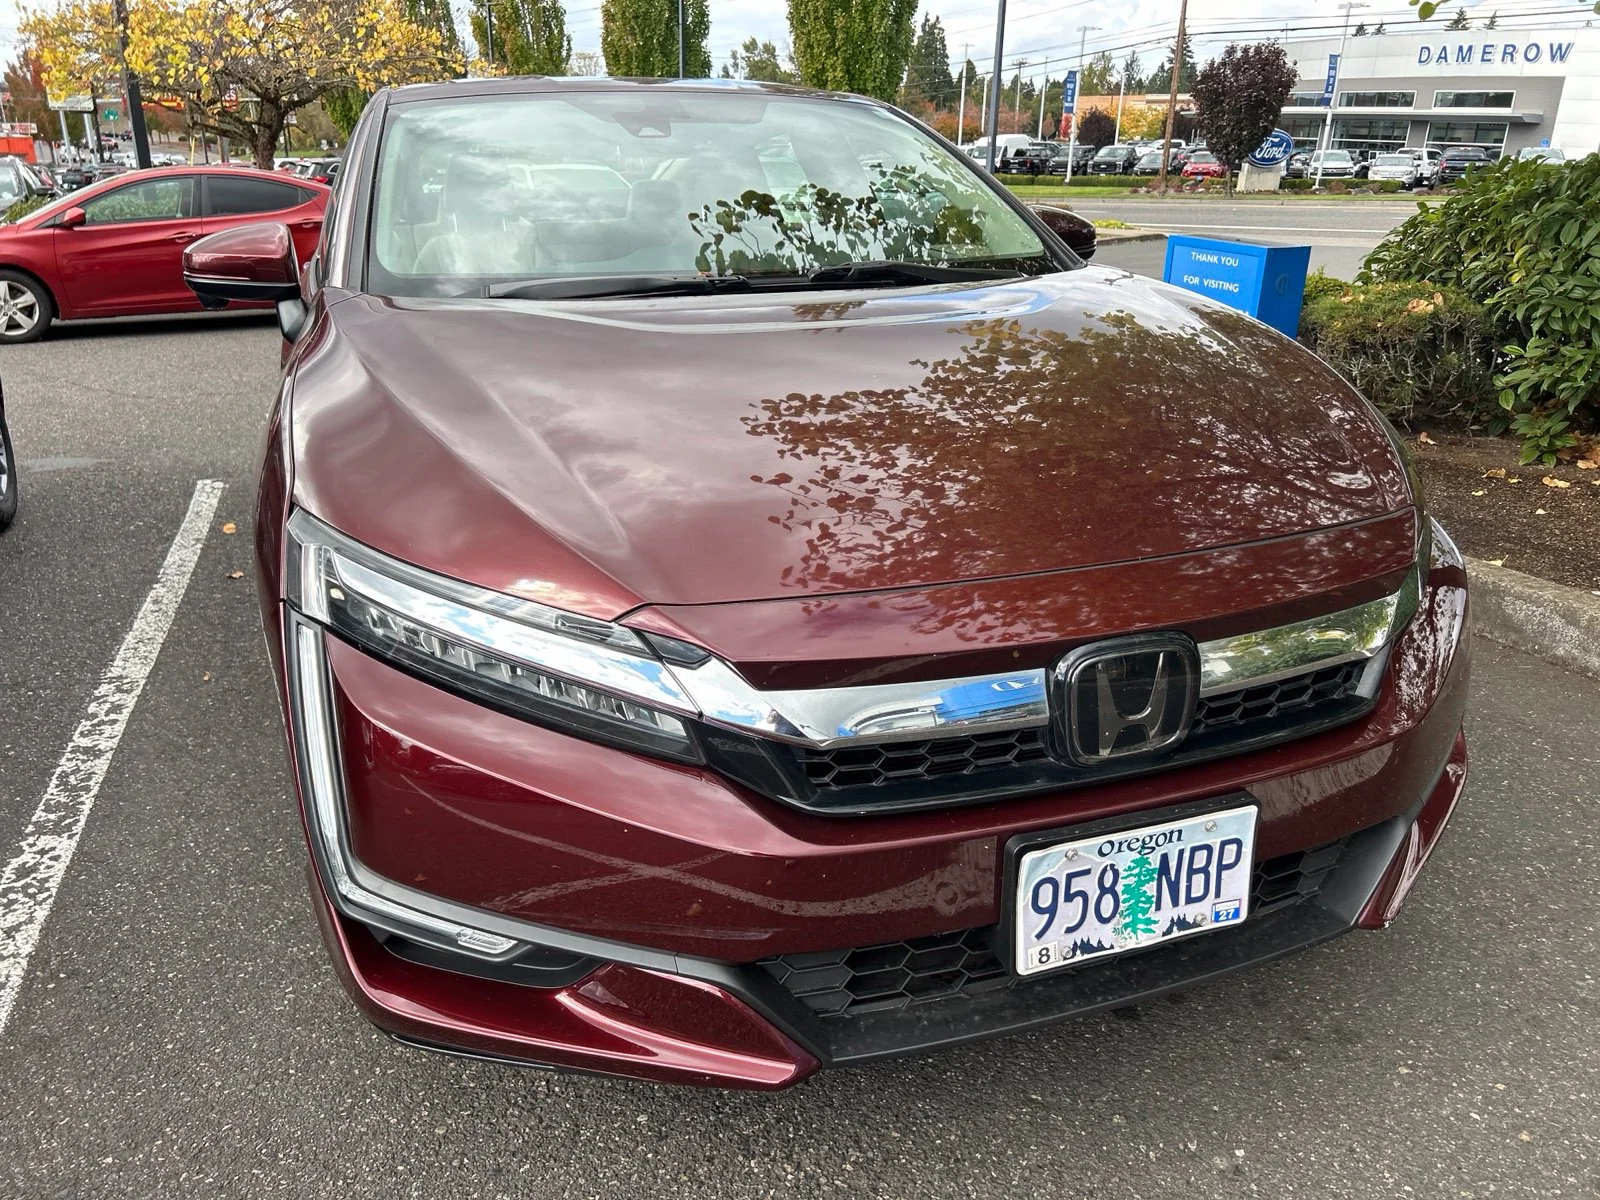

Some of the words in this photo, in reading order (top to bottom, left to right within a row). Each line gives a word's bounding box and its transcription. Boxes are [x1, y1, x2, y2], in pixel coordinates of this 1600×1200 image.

[1418, 42, 1574, 64] DAMEROW
[1255, 137, 1287, 159] Ford
[1191, 252, 1218, 264] THANK
[1221, 256, 1238, 267] YOU
[1183, 275, 1199, 285] FOR
[1203, 279, 1239, 292] VISITING
[1098, 828, 1184, 857] Oregon
[1030, 863, 1120, 941] 958
[1154, 837, 1244, 911] NBP
[1219, 909, 1235, 921] 27
[1038, 947, 1050, 965] 8
